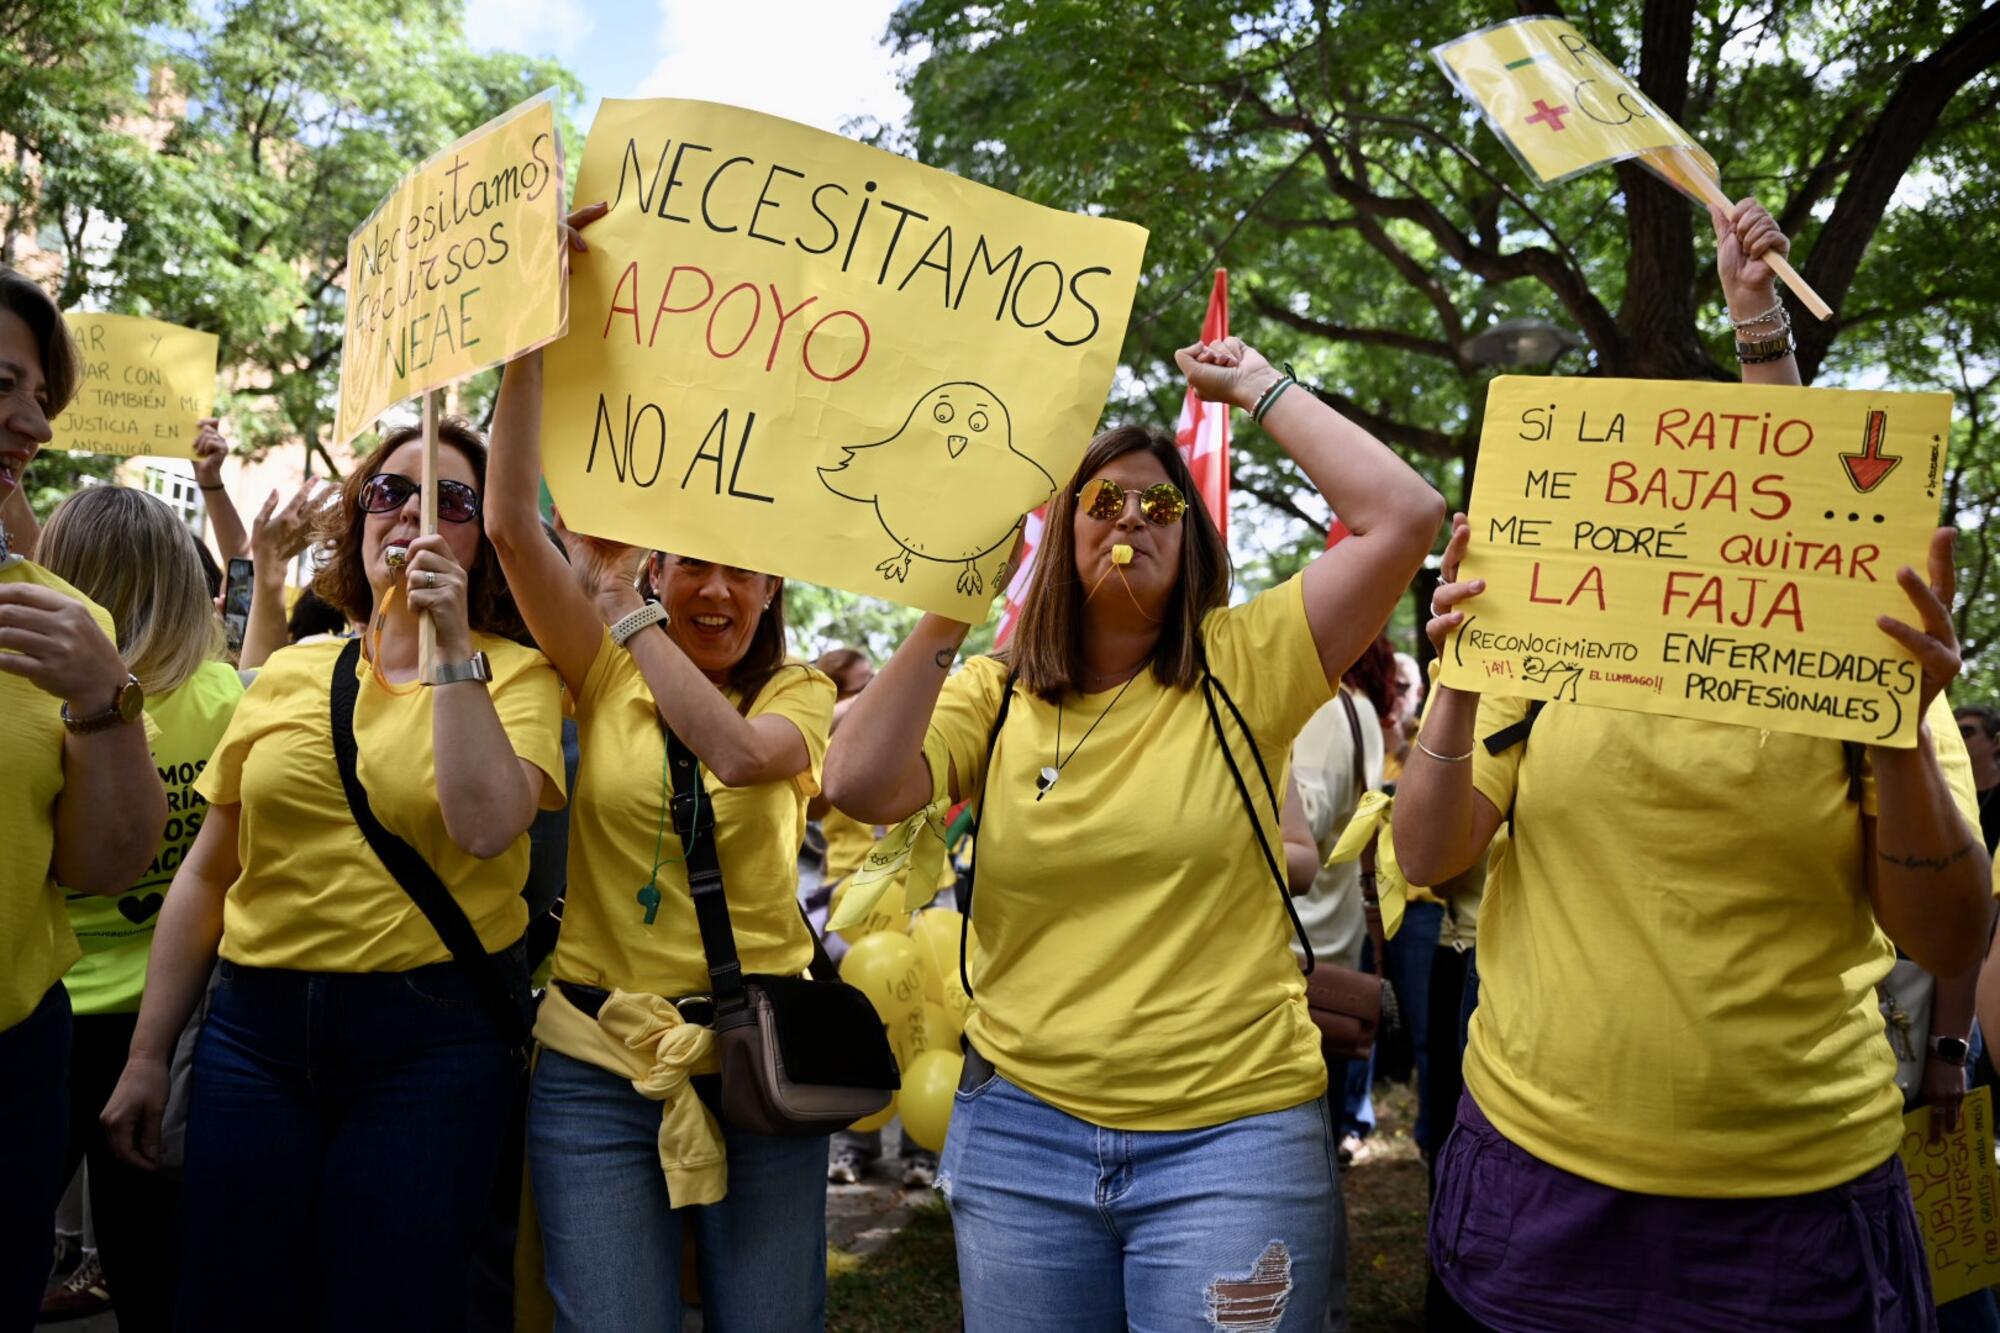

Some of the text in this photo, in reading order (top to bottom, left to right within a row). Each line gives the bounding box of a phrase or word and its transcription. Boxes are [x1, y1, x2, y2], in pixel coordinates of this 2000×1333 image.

[358, 132, 550, 284] Necesitamos
[386, 286, 481, 385] NEAE
[603, 261, 871, 382] APOYO
[123, 365, 161, 386] CON
[91, 388, 166, 409] TAMBIÉN
[154, 423, 179, 439] EN
[586, 393, 775, 504] NO AL
[1578, 410, 1625, 443] LA
[1525, 470, 1577, 499] ME
[1489, 515, 1552, 546] ME
[1574, 522, 1688, 559] PODRÉ
[1529, 562, 1805, 632] LA FAJA
[1589, 671, 1602, 681] EL
[1663, 632, 1916, 695] ENFERMEDADES
